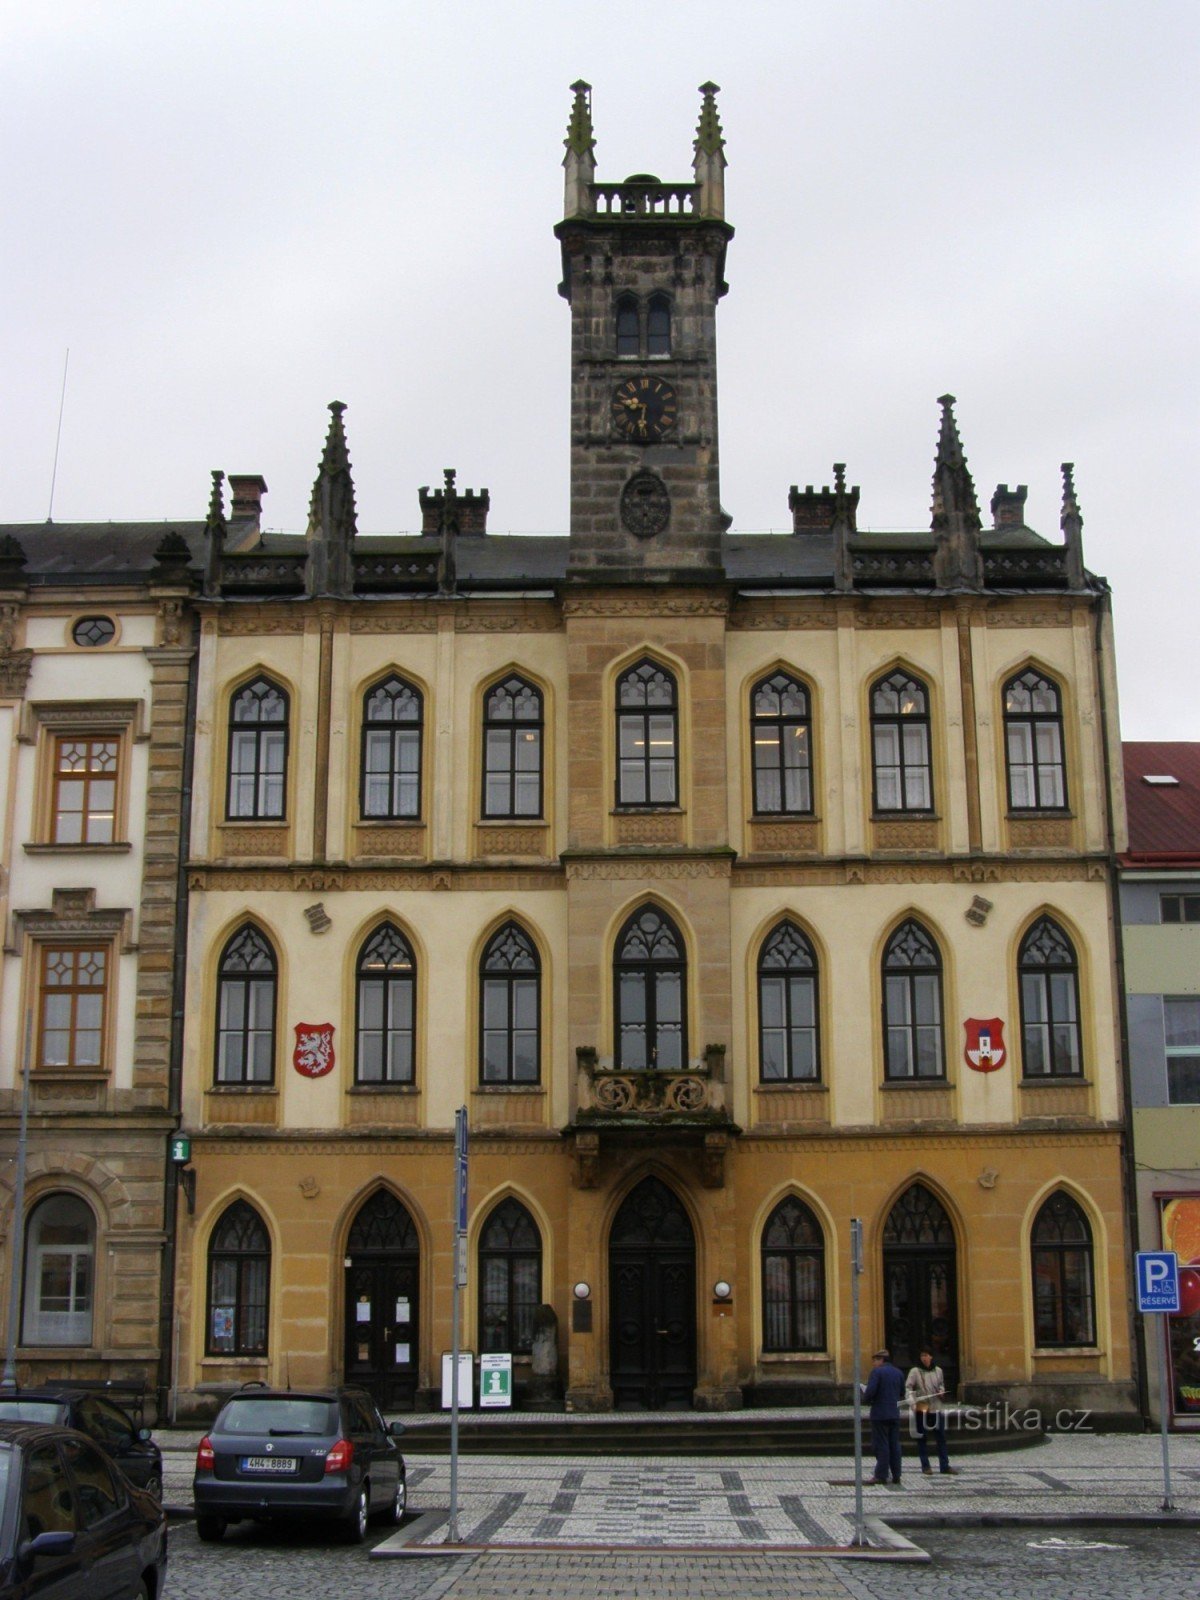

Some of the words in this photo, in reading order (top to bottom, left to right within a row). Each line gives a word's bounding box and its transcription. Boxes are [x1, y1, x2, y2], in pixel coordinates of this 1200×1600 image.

[1145, 1259, 1169, 1293] P
[249, 1458, 265, 1468] 4H4
[271, 1459, 293, 1469] 8889
